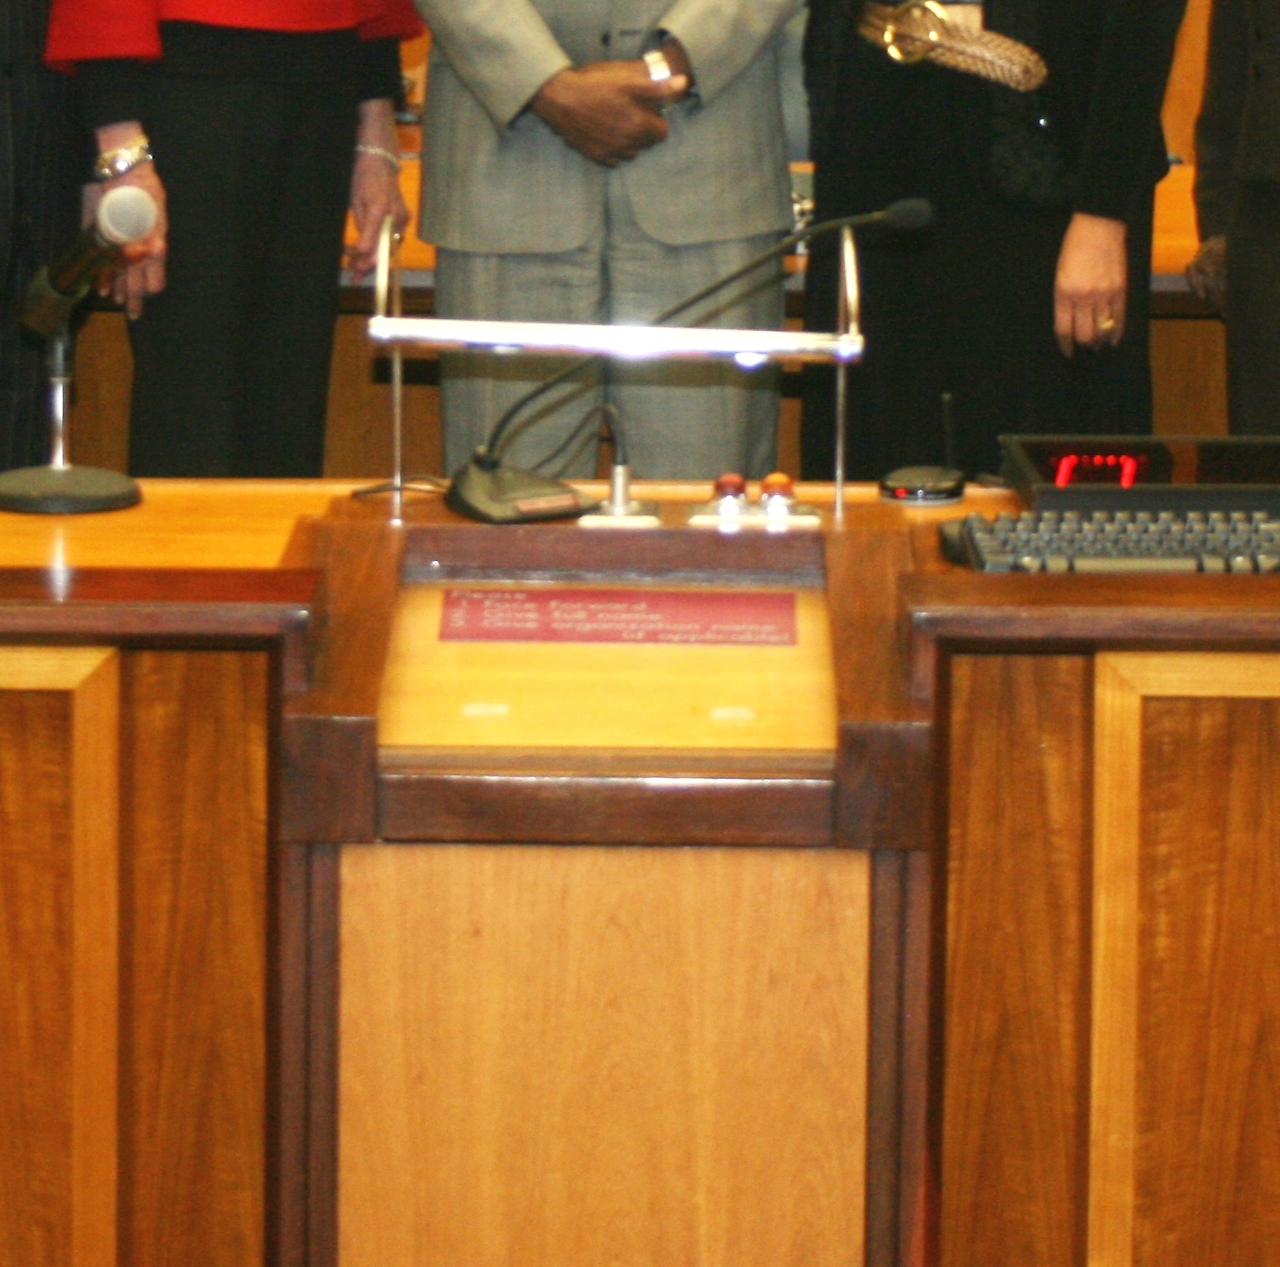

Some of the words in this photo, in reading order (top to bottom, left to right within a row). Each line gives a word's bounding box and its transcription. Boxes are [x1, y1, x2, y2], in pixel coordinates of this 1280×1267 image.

[484, 599, 537, 611] Face
[484, 609, 540, 620] Give
[551, 610, 587, 620] full
[482, 619, 540, 630] Give
[550, 621, 701, 633] organization
[710, 623, 776, 633] name
